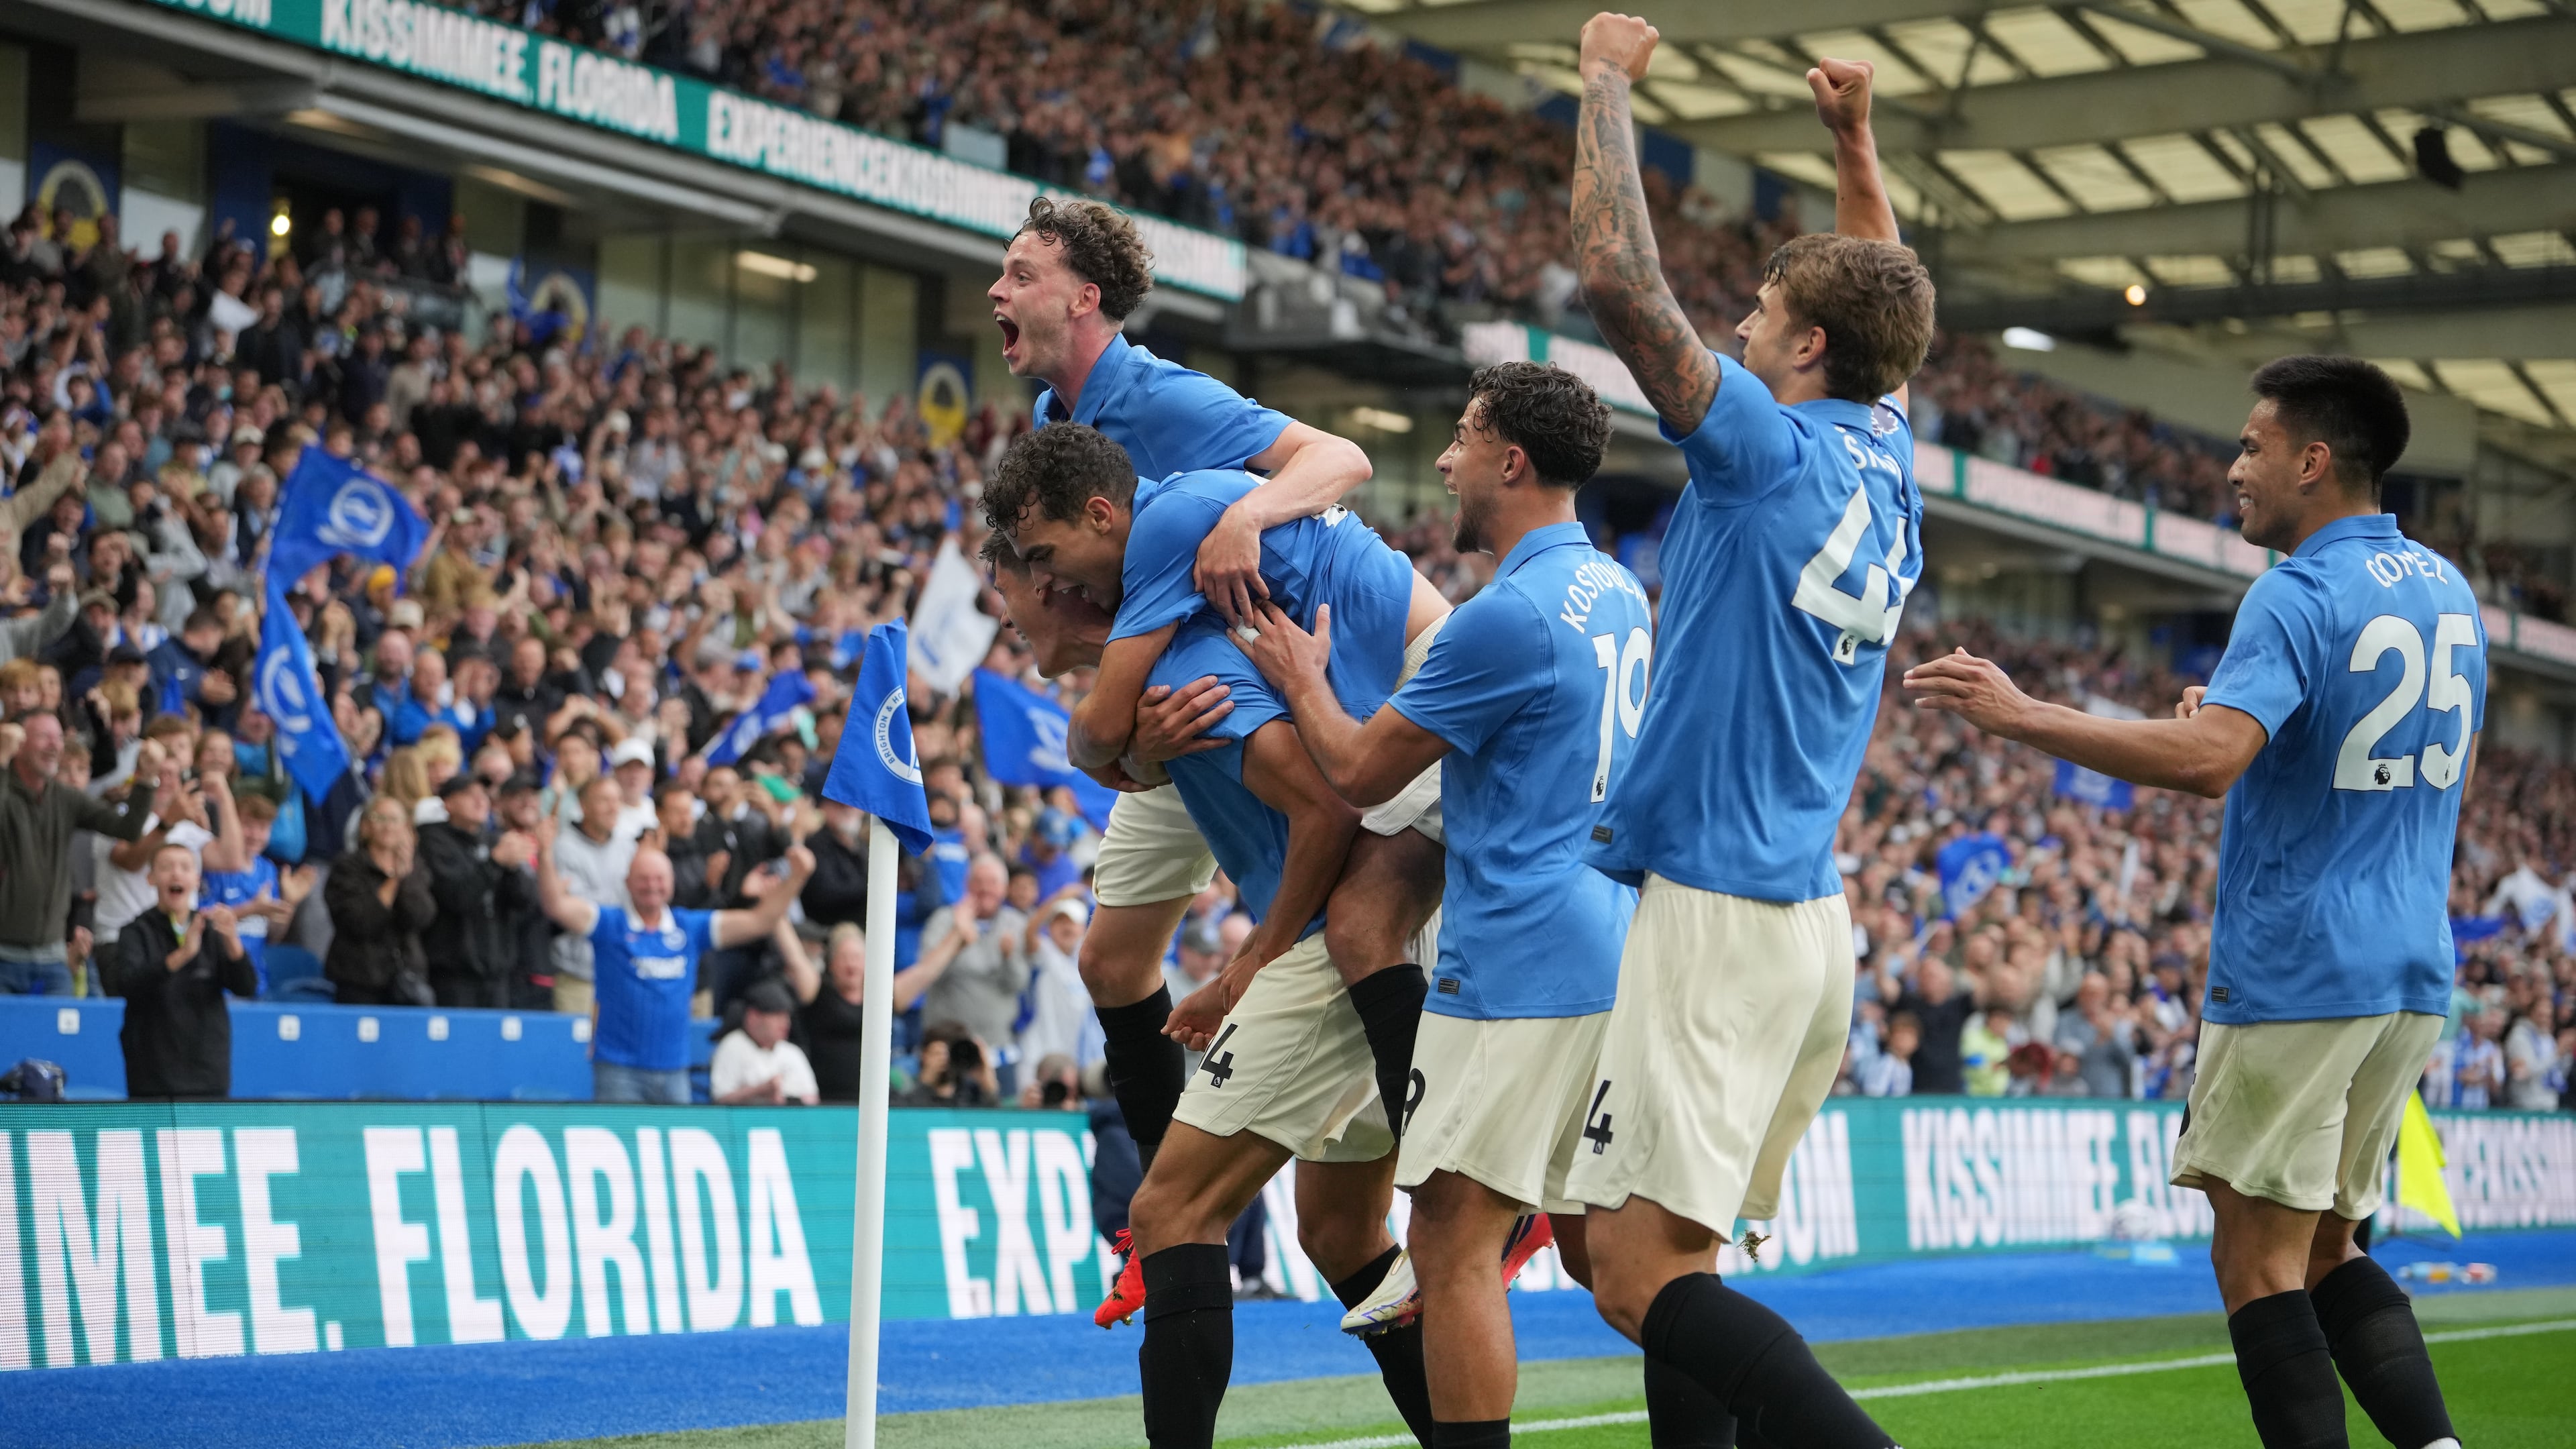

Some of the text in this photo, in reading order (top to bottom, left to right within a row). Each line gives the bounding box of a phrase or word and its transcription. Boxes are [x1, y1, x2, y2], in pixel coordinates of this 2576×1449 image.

[538, 39, 680, 145] FLORIDA
[2365, 551, 2449, 588] GOMEZ
[878, 715, 896, 764] BRIGHTON
[2332, 612, 2478, 791] 25
[1195, 1023, 1238, 1088] 4
[1583, 1079, 1614, 1155] 4
[362, 1124, 824, 1348] FLORIDA
